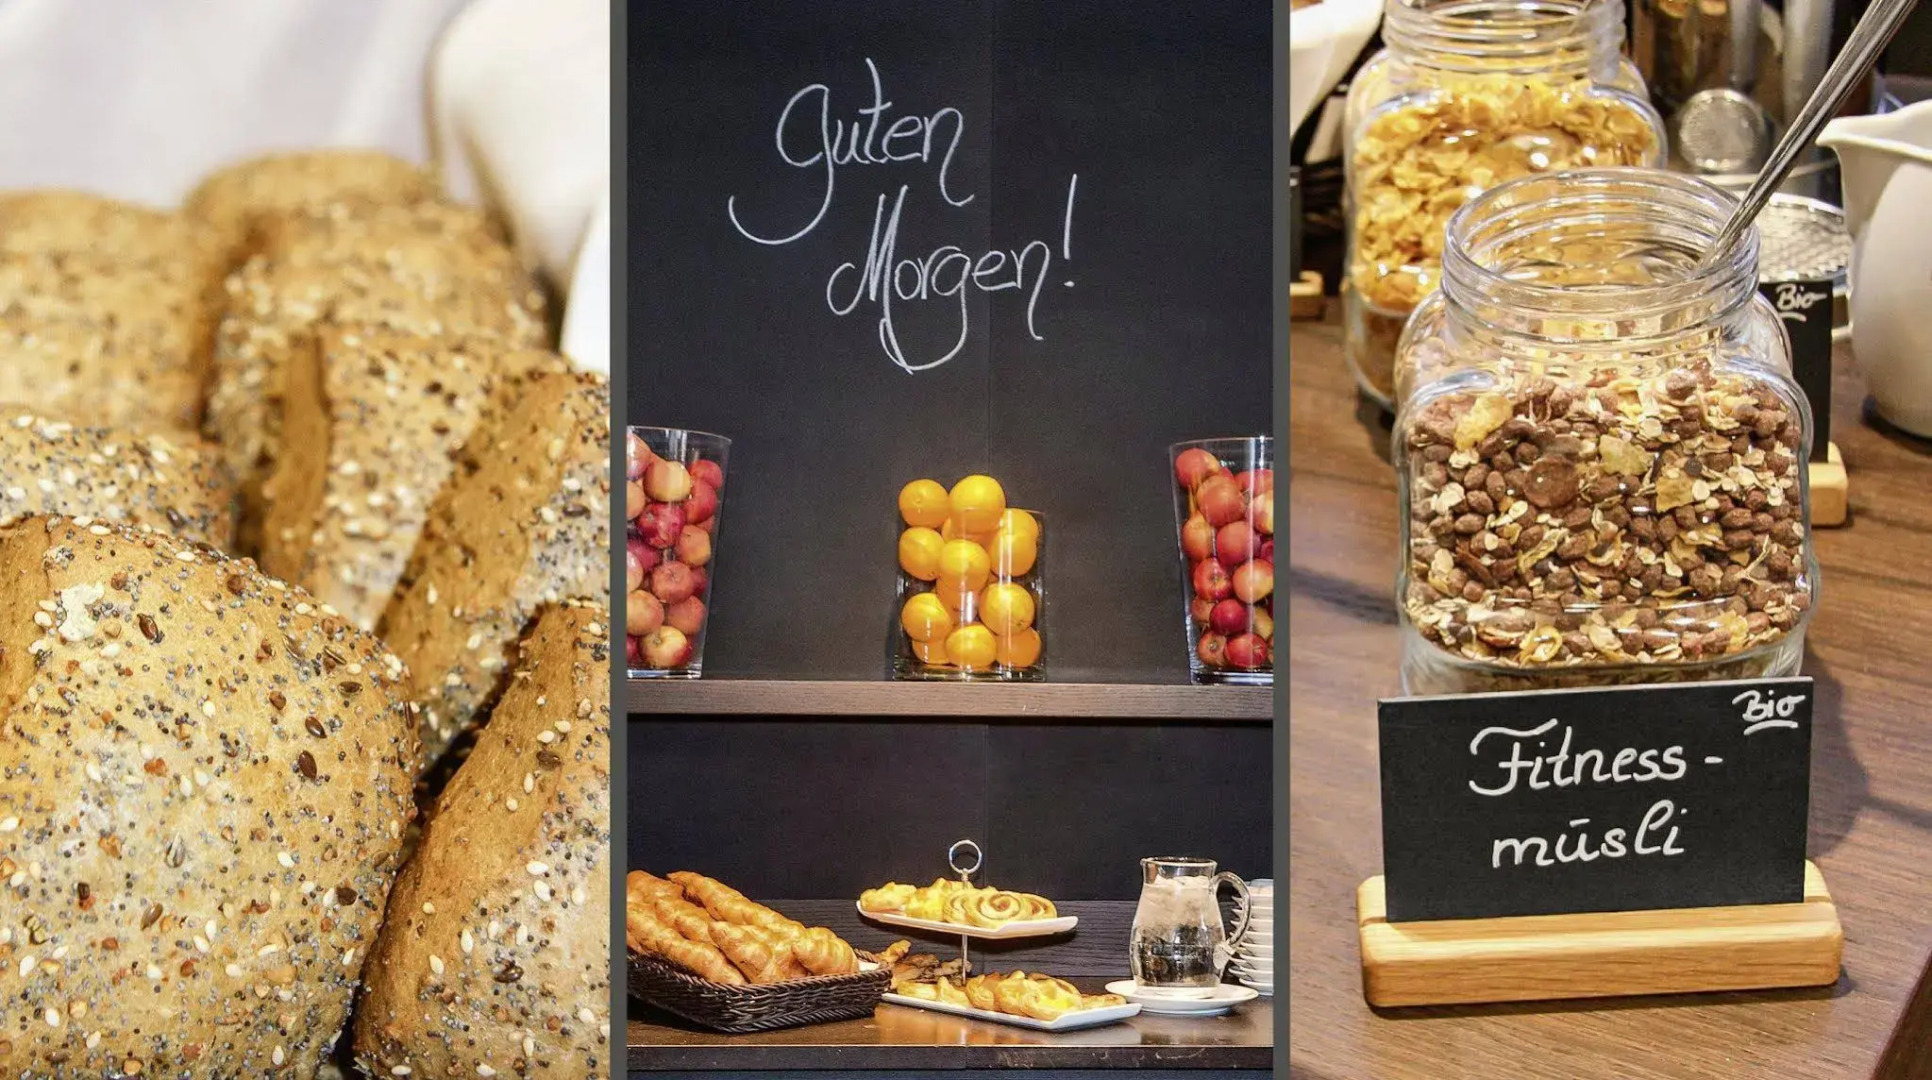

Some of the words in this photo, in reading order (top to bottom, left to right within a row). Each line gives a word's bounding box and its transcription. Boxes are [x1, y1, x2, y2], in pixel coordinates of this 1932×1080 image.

[826, 172, 1079, 375] Morgen!
[1775, 283, 1828, 311] Bio
[1732, 690, 1806, 722] Bio
